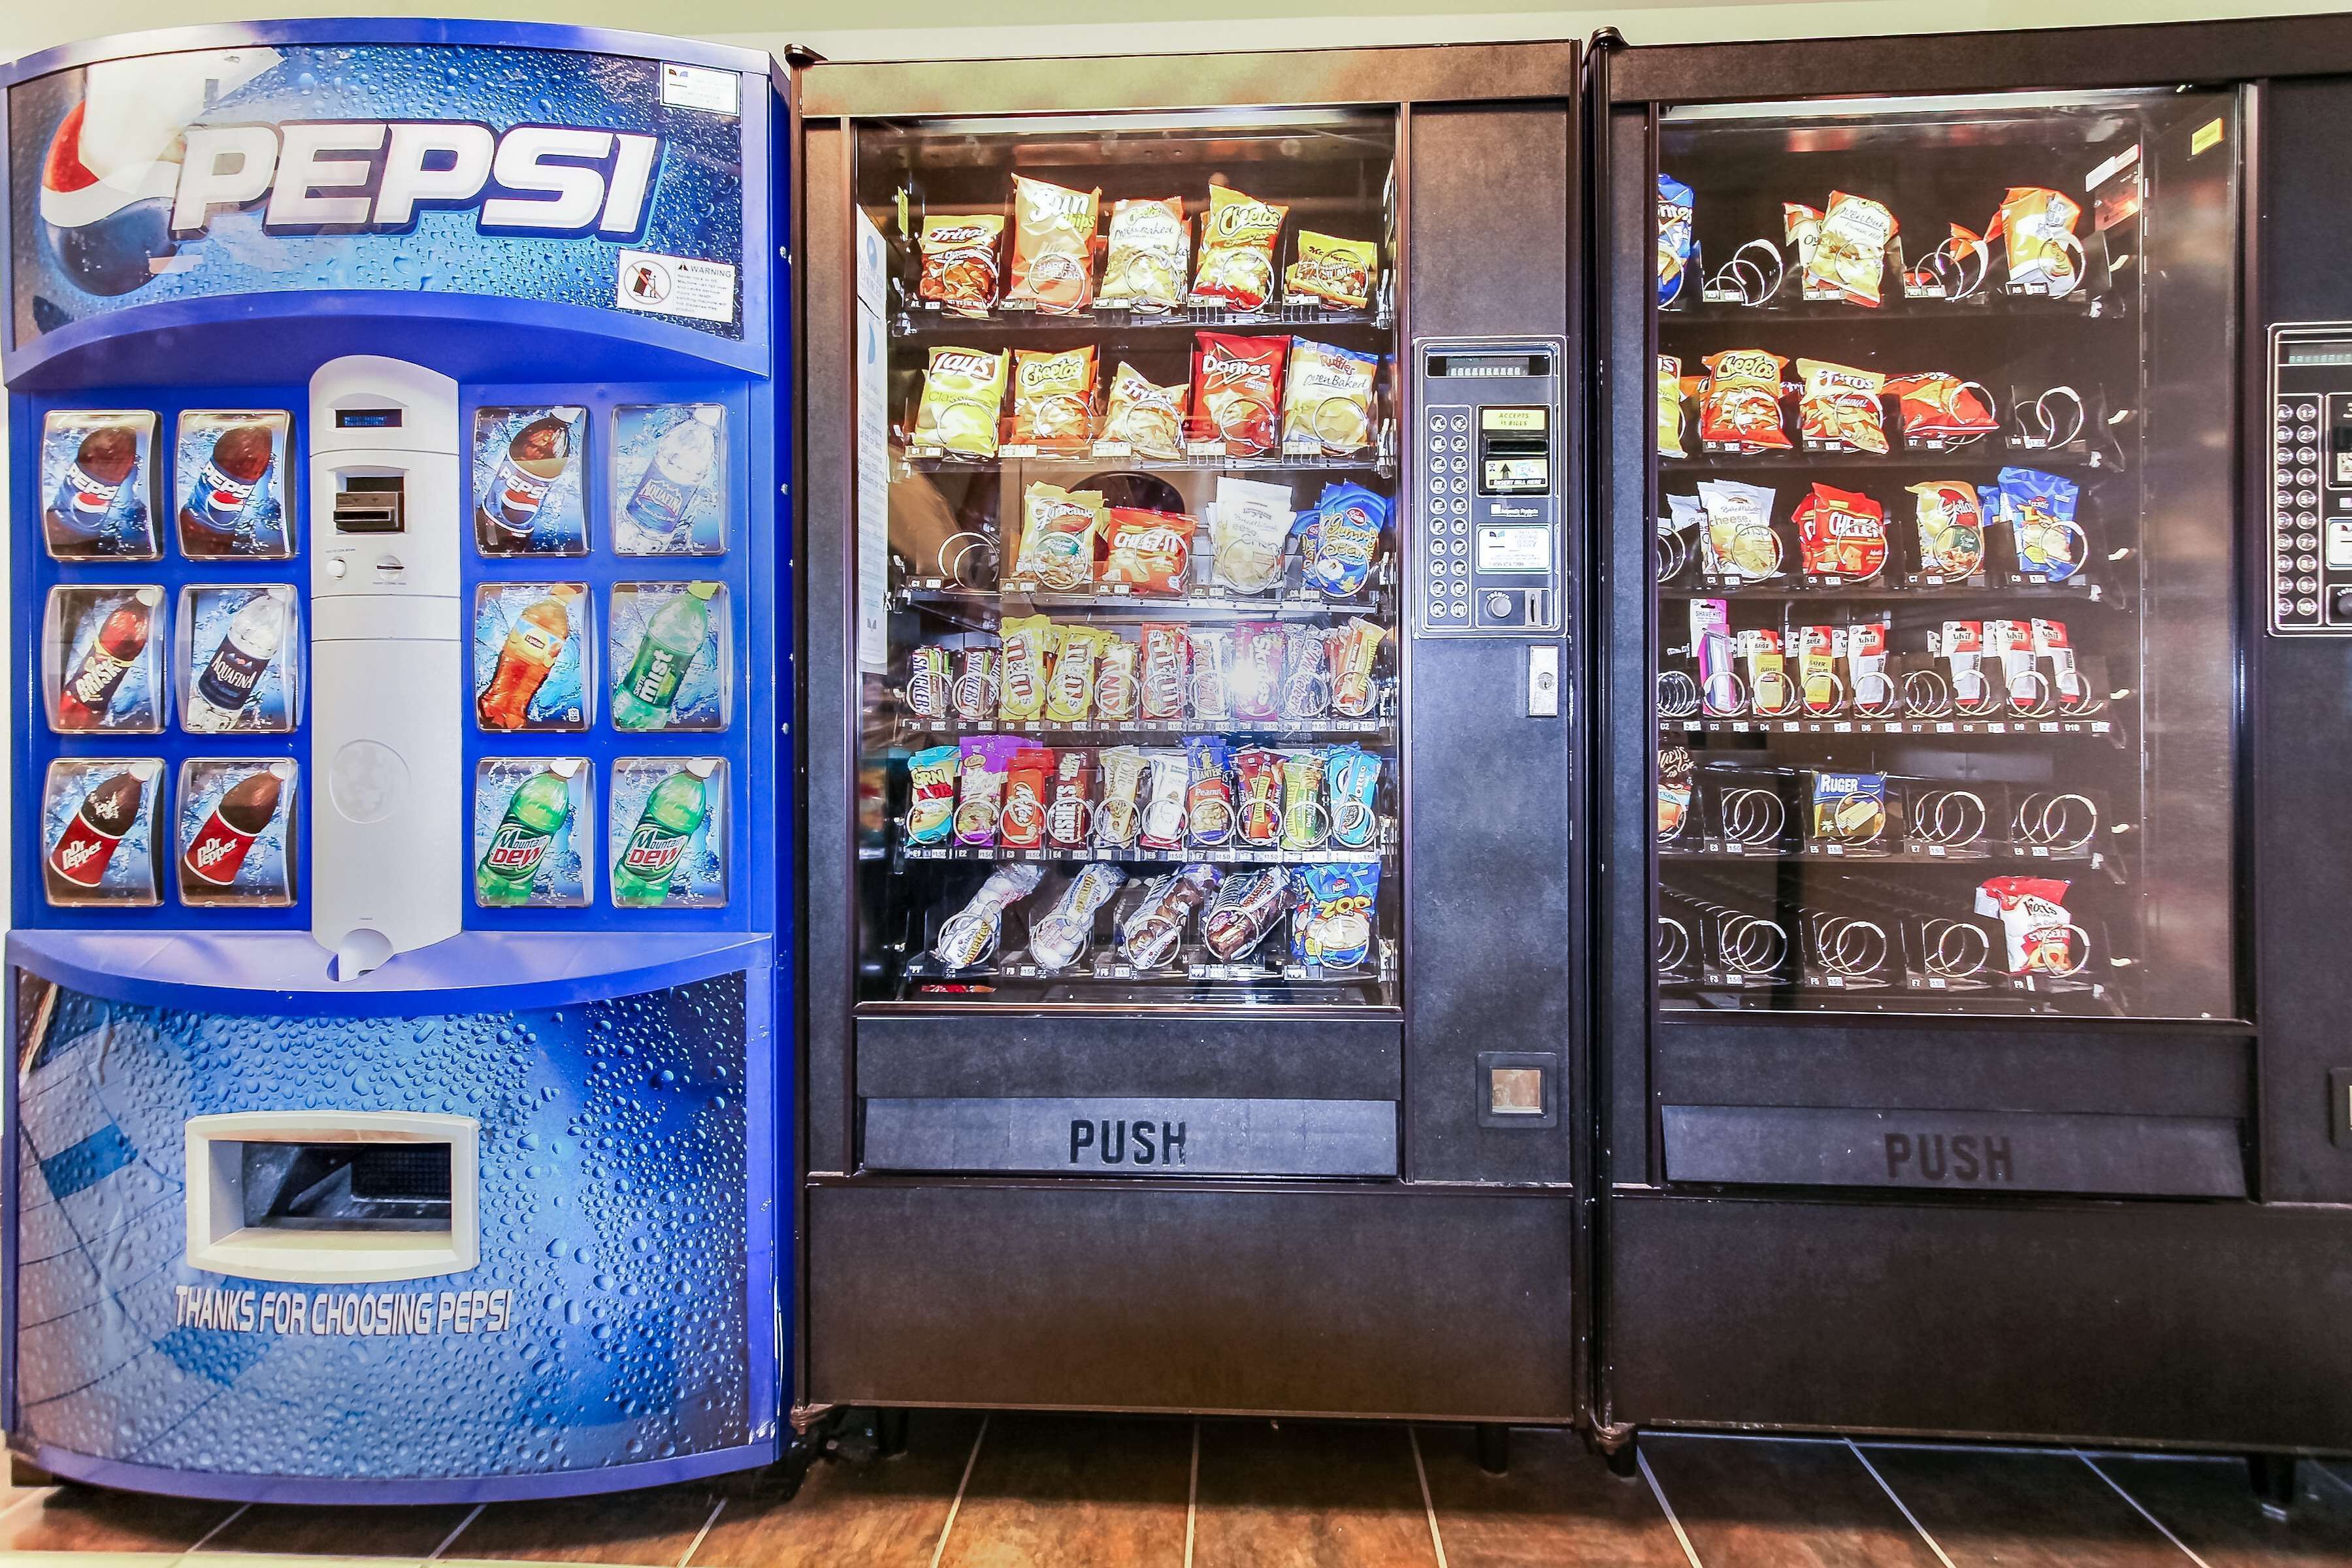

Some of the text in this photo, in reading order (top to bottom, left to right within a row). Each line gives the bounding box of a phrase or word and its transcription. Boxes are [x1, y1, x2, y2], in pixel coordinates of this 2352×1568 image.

[171, 122, 659, 234] PEPSI
[1028, 188, 1090, 223] Sun
[1217, 204, 1281, 237] Cheetos
[691, 266, 732, 278] WARNING
[930, 353, 996, 381] Lay's
[1021, 359, 1083, 385] Cheetos
[1202, 355, 1272, 377] Doritos
[1320, 353, 1356, 376] Ruffles
[1716, 355, 1776, 381] Cheetos
[1709, 515, 1749, 527] cheese
[525, 634, 545, 649] Lipton
[212, 651, 256, 689] AQUAFINA
[640, 649, 674, 703] mist
[963, 653, 983, 709] SNICKERS
[913, 656, 930, 715] SNICKERS
[1820, 774, 1859, 793] RUGER
[62, 840, 102, 871] Pepper
[71, 840, 86, 857] Dr
[197, 838, 238, 869] Pepper
[205, 837, 221, 857] Dr
[1320, 896, 1372, 917] ZOO
[1070, 1120, 1186, 1166] PUSH
[1884, 1133, 2014, 1181] PUSH
[174, 1284, 514, 1336] THANKS FOR CHOOSING PEPSI
